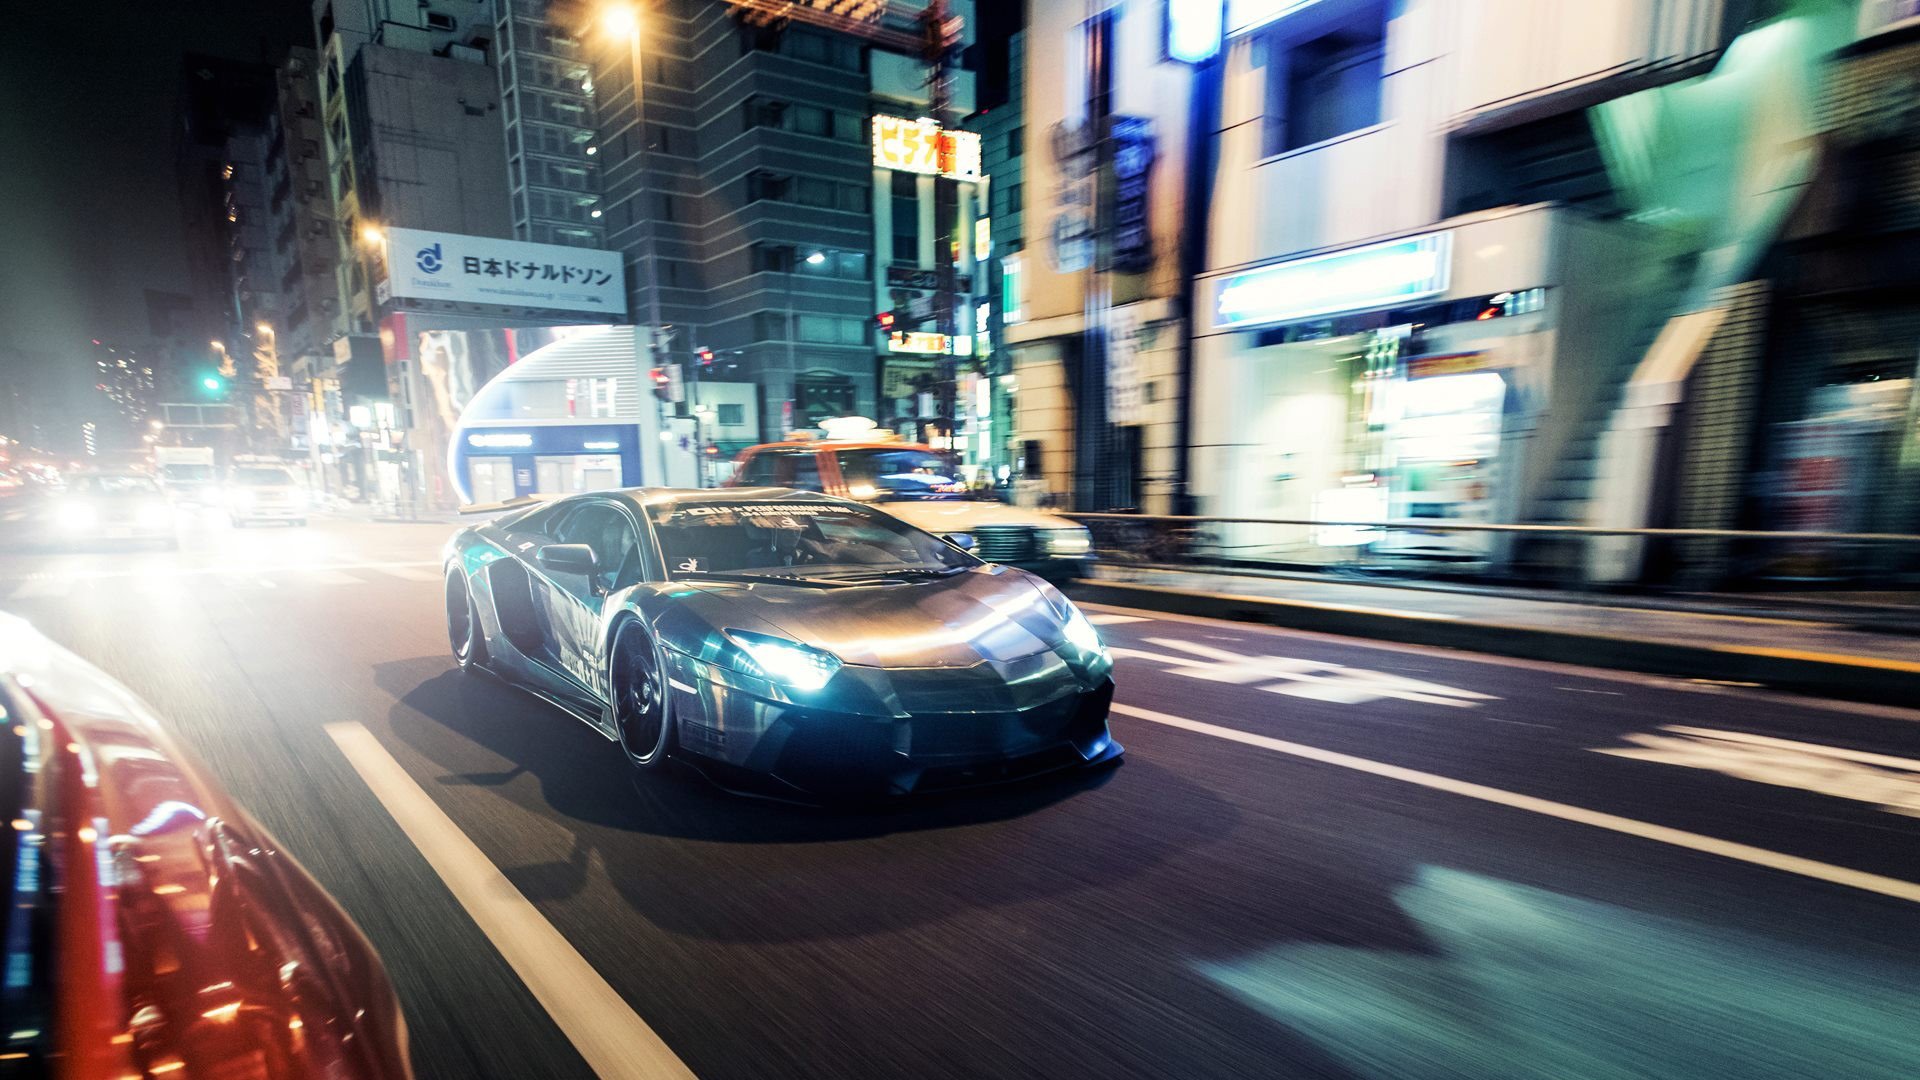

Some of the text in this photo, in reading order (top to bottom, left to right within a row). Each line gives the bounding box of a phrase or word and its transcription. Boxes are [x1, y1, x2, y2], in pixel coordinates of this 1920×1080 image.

[463, 256, 613, 286] 日本ドナルドソン
